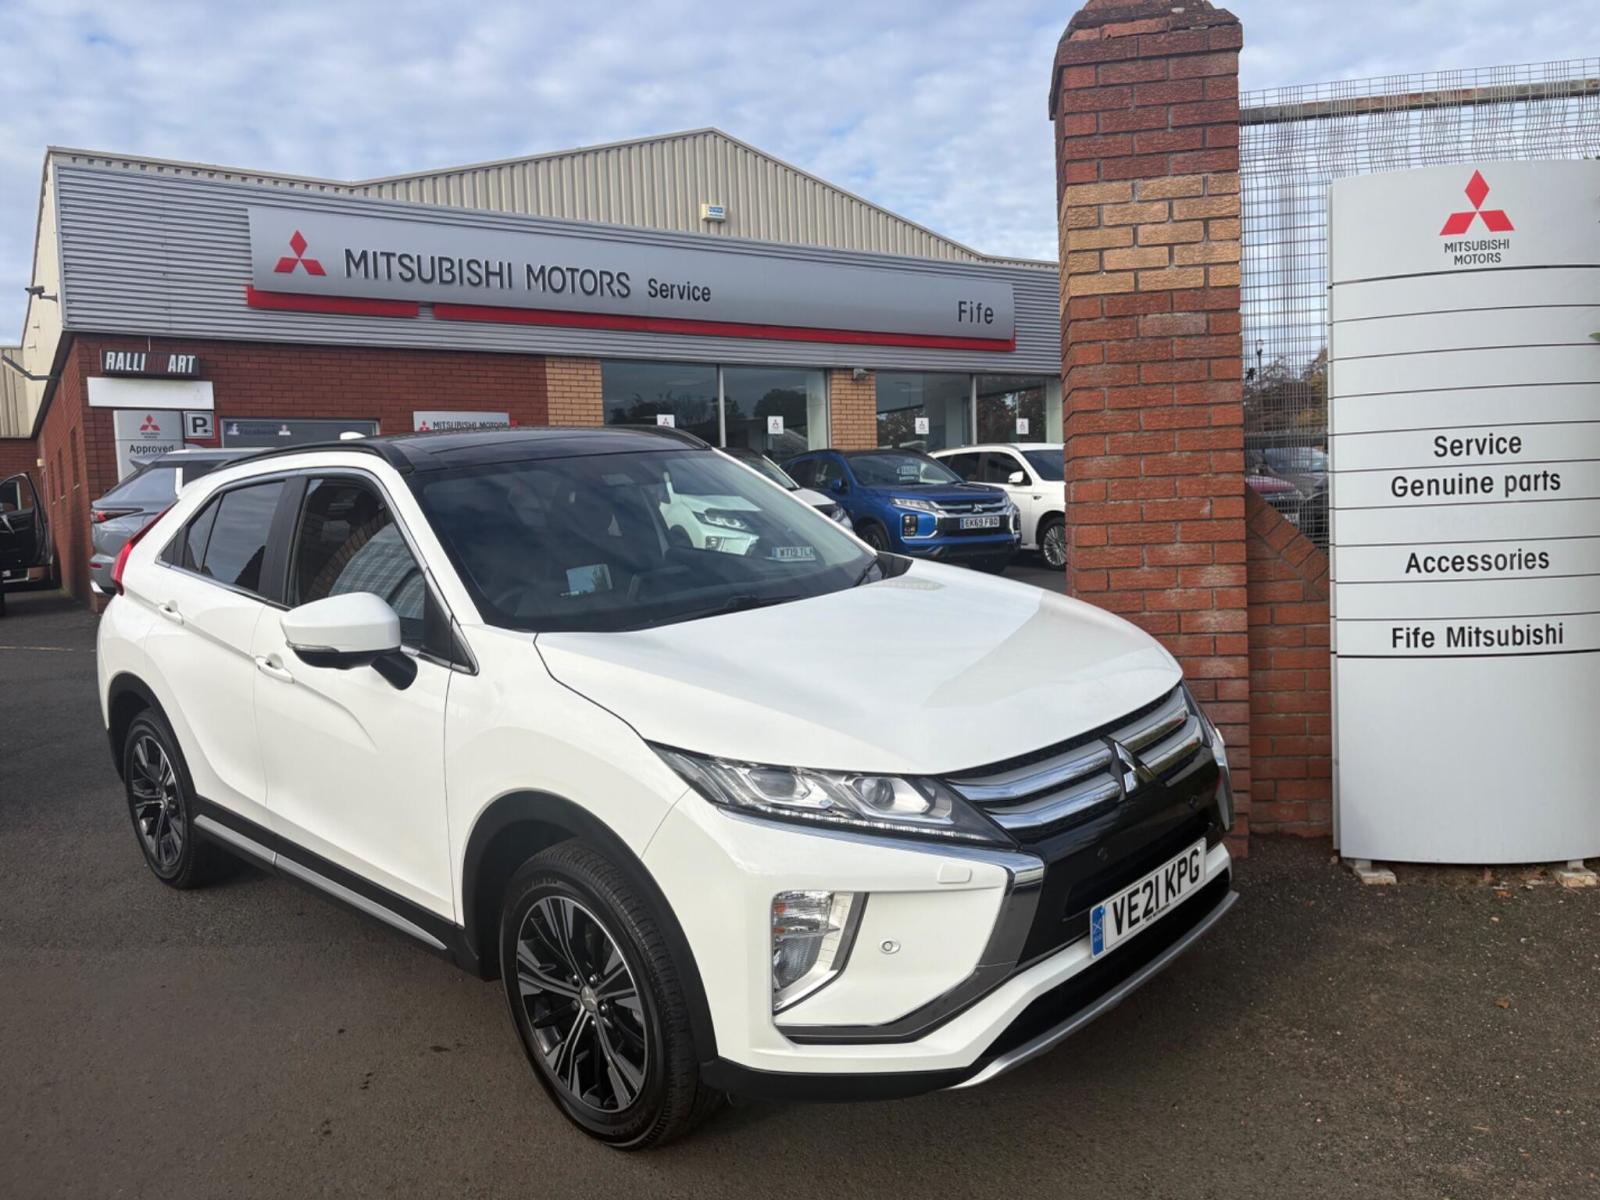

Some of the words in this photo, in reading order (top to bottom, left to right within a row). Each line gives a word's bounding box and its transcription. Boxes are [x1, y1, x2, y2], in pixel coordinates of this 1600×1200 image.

[1444, 238, 1510, 253] MITSUBISHI
[1453, 252, 1502, 265] MOTORS
[344, 247, 513, 290] MITSUBISHI
[526, 262, 632, 298] MOTORS
[648, 278, 711, 303] Service
[957, 300, 995, 325] Fife
[105, 351, 146, 371] RALLI
[167, 354, 196, 373] ART
[129, 444, 175, 456] Approved
[1433, 432, 1522, 458] Service
[1391, 473, 1494, 497] Genuine
[1504, 470, 1562, 498] parts
[1405, 548, 1550, 574] Accessories
[1391, 626, 1435, 649] Fife
[1446, 622, 1564, 648] Mitsubishi
[1113, 875, 1160, 936] VE21
[1165, 848, 1200, 903] KPG
